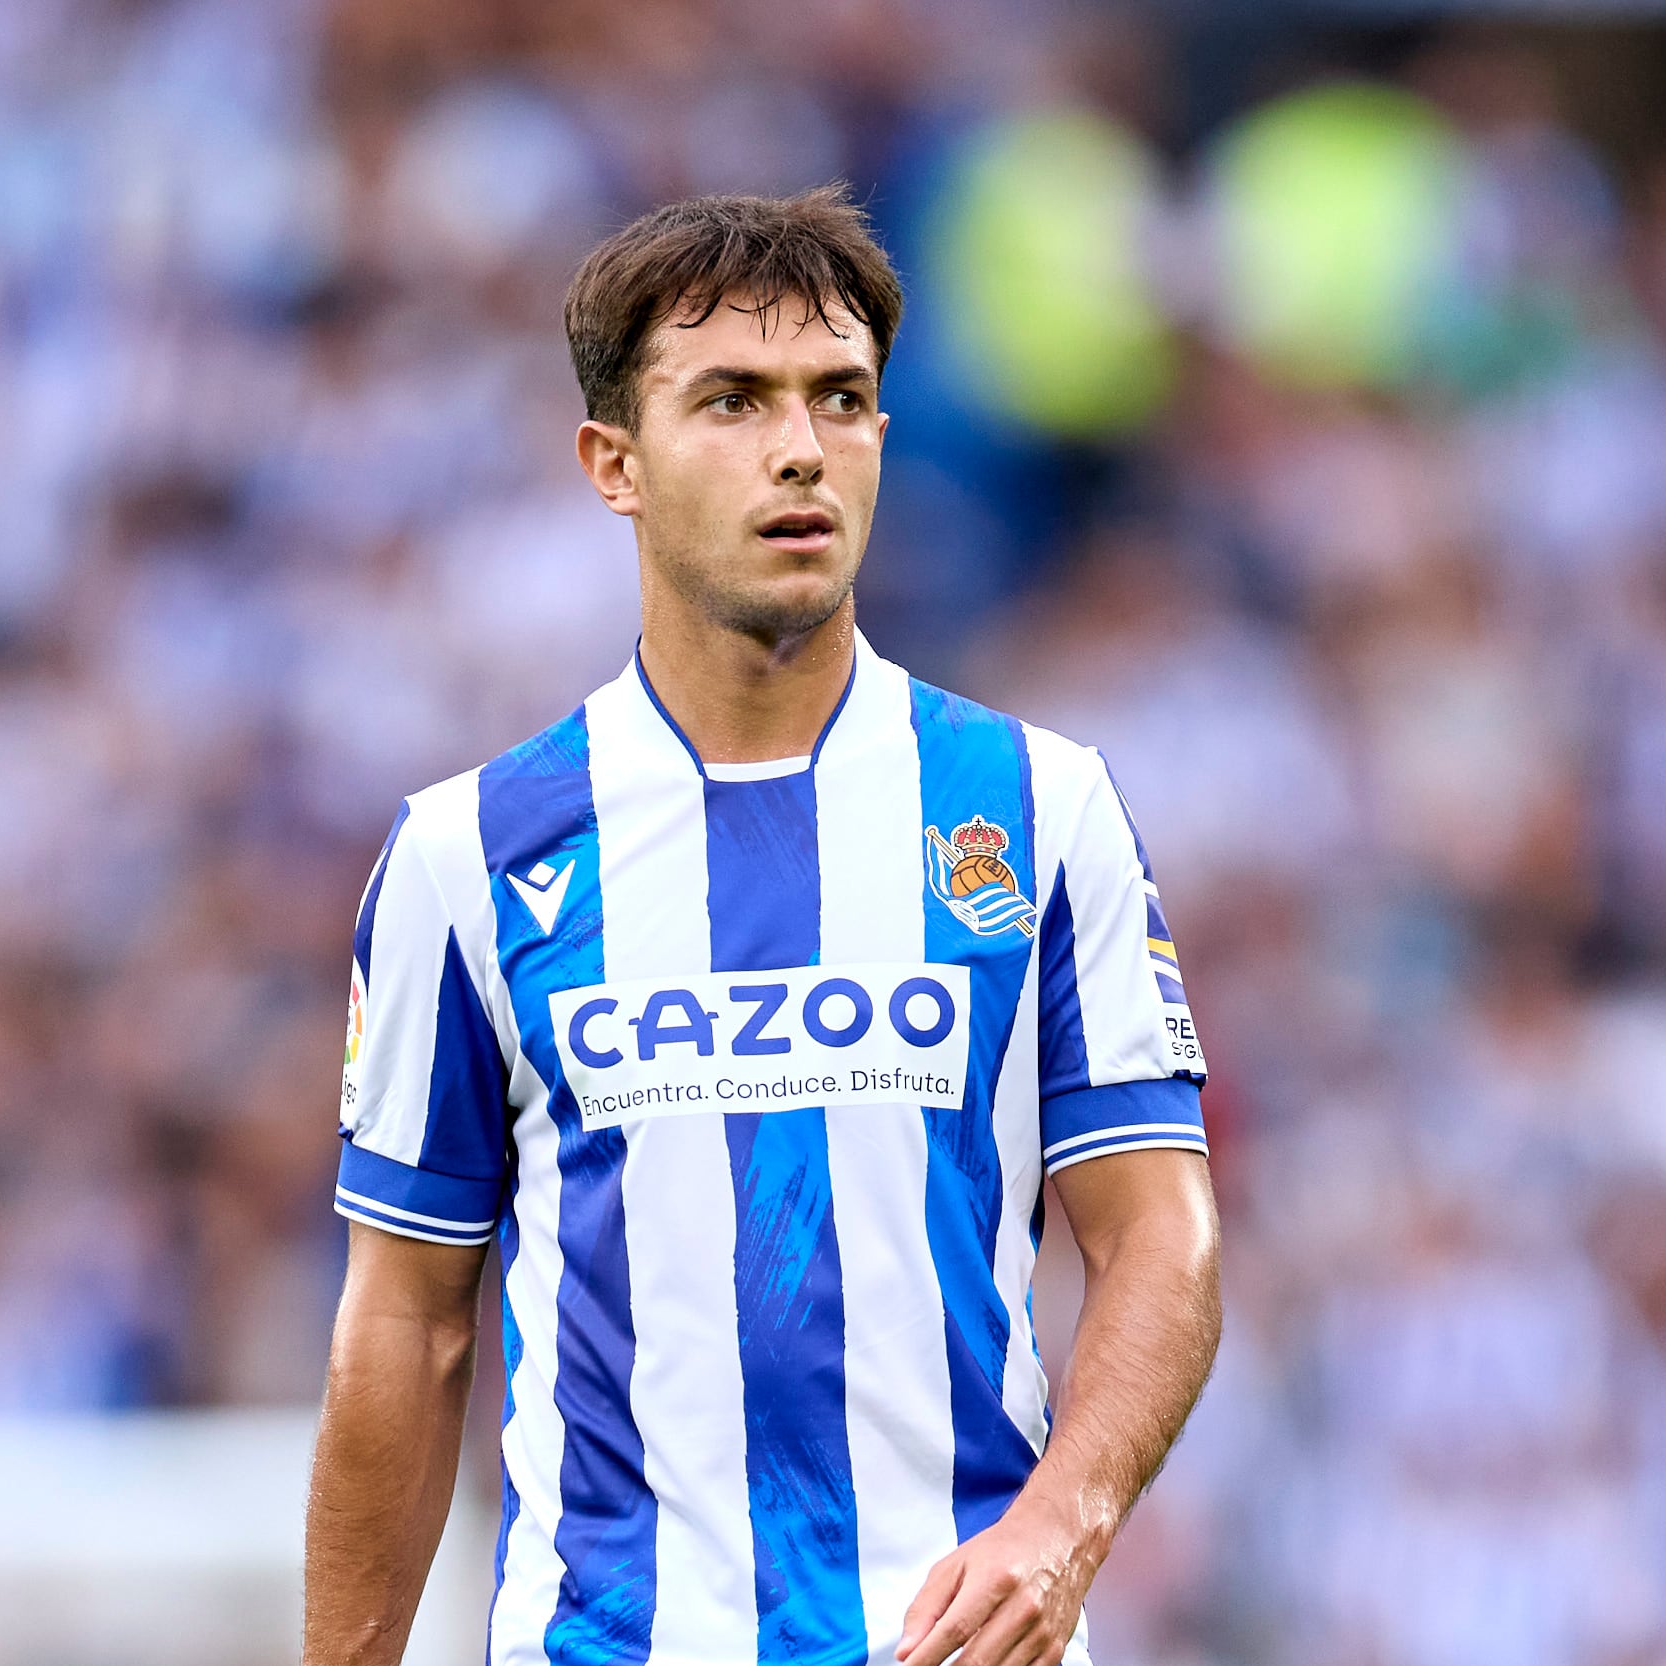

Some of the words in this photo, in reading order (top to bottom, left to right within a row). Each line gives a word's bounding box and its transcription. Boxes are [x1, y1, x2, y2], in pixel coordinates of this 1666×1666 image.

[568, 976, 956, 1069] CAZOO
[1165, 1017, 1197, 1040] RE
[583, 1080, 710, 1117] Encuentra.
[715, 1073, 842, 1100] Conduce.
[850, 1067, 956, 1096] Disfruta.
